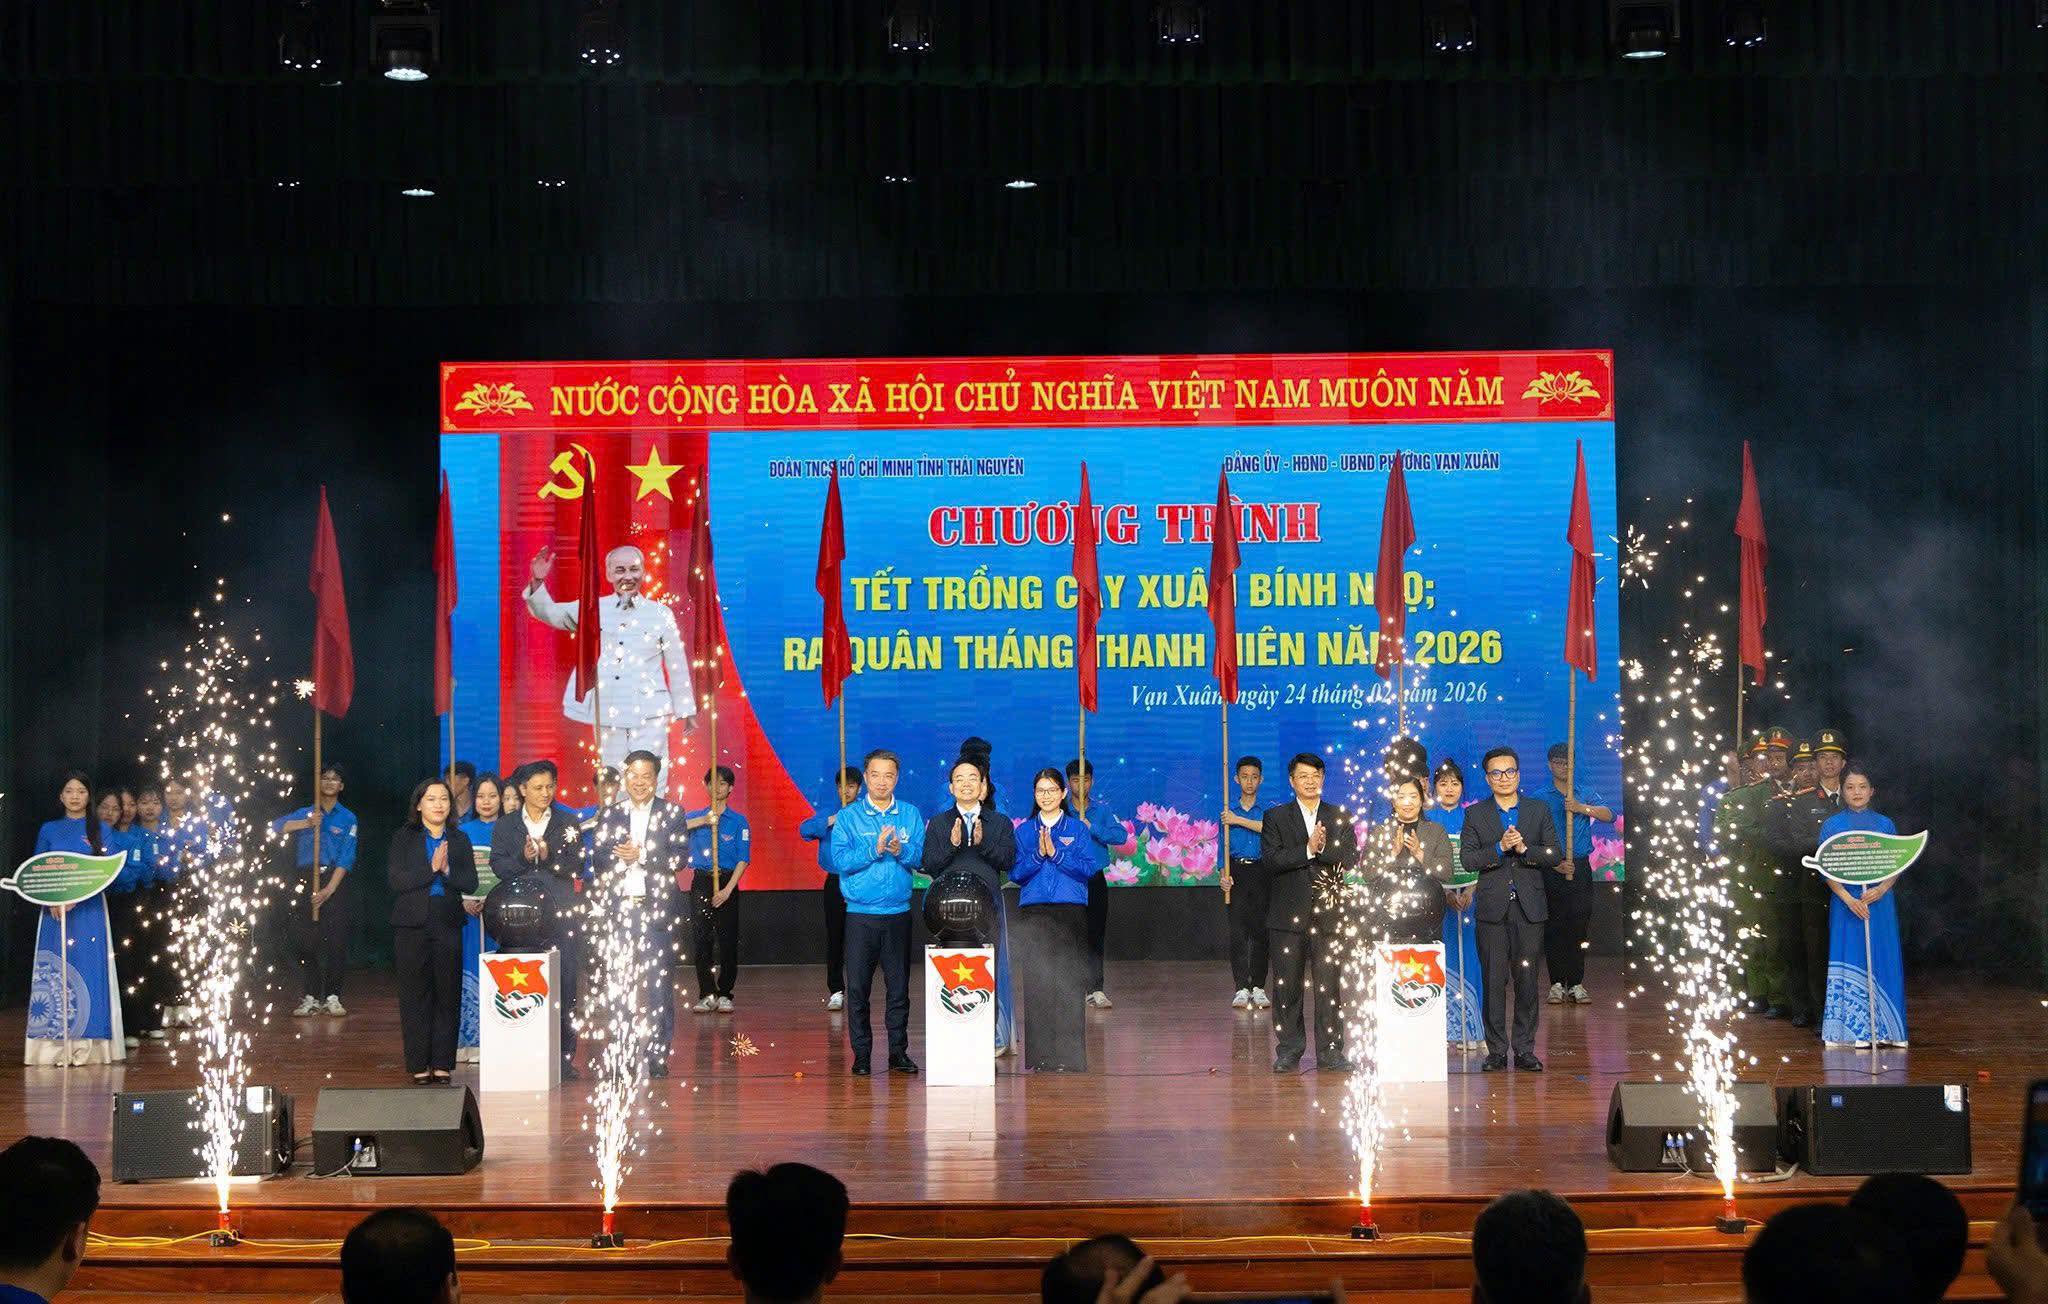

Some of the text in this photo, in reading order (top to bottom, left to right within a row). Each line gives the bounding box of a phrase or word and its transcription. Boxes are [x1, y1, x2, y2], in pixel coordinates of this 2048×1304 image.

[550, 367, 1504, 423] NƯỚC CỘNG HÒA XÃ HỘI CHỦ NGHĨA VIỆT NAM MUÔN NĂM
[769, 456, 802, 478] ĐOÀN
[839, 454, 855, 477] HỒ
[859, 457, 878, 477] CHÍ
[882, 459, 914, 477] MINH
[946, 455, 973, 476] THÁI
[976, 455, 1024, 476] NGUYÊN
[1225, 450, 1261, 473] ĐẢNG
[1263, 450, 1280, 473] ỦY
[1292, 455, 1328, 472] HĐND
[1340, 454, 1376, 471] UBND
[1434, 452, 1460, 474] VẠN
[1463, 449, 1500, 470] XUÂN
[1156, 494, 1321, 543] TRÌNH
[850, 564, 1435, 613] TẾT TRỒNG CY XUÂ BÍNH NỌ;
[783, 637, 824, 671] RA
[848, 629, 943, 674] QUÂN
[953, 627, 1074, 669] THÁNG
[1317, 624, 1380, 666] NĂ
[1414, 630, 1502, 665] 2026
[1132, 685, 1168, 711] Vạn
[1235, 684, 1280, 711] ngày
[1284, 683, 1306, 705] 24
[1311, 682, 1364, 710] tháng
[1443, 681, 1488, 703] 2026
